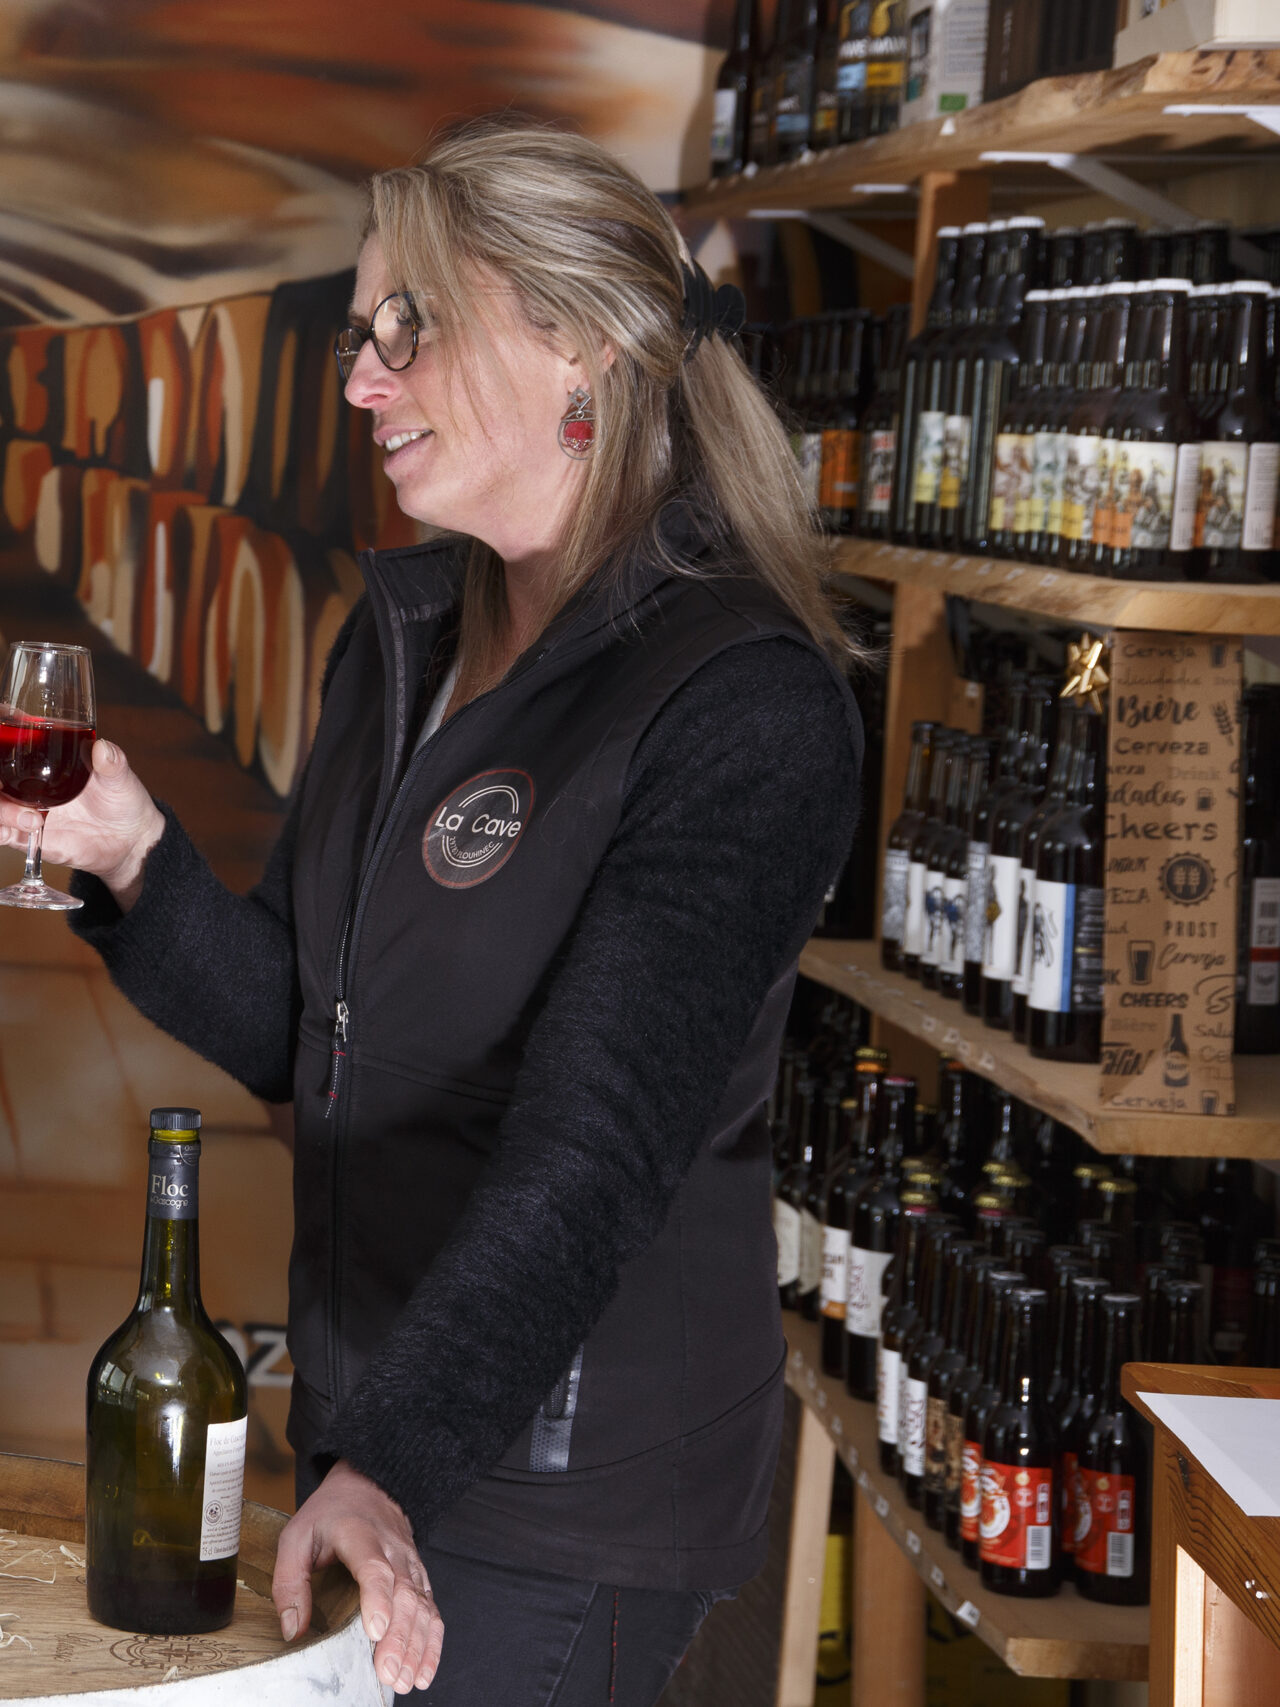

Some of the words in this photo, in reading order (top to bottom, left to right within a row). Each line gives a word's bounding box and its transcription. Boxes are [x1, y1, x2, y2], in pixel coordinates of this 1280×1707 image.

[1116, 694, 1201, 729] Bière
[1114, 736, 1210, 756] Cerveza
[434, 806, 464, 831] La
[471, 814, 522, 838] Cave
[1163, 920, 1218, 938] PROST
[1120, 992, 1190, 1008] CHEERS
[151, 1174, 189, 1197] Floc
